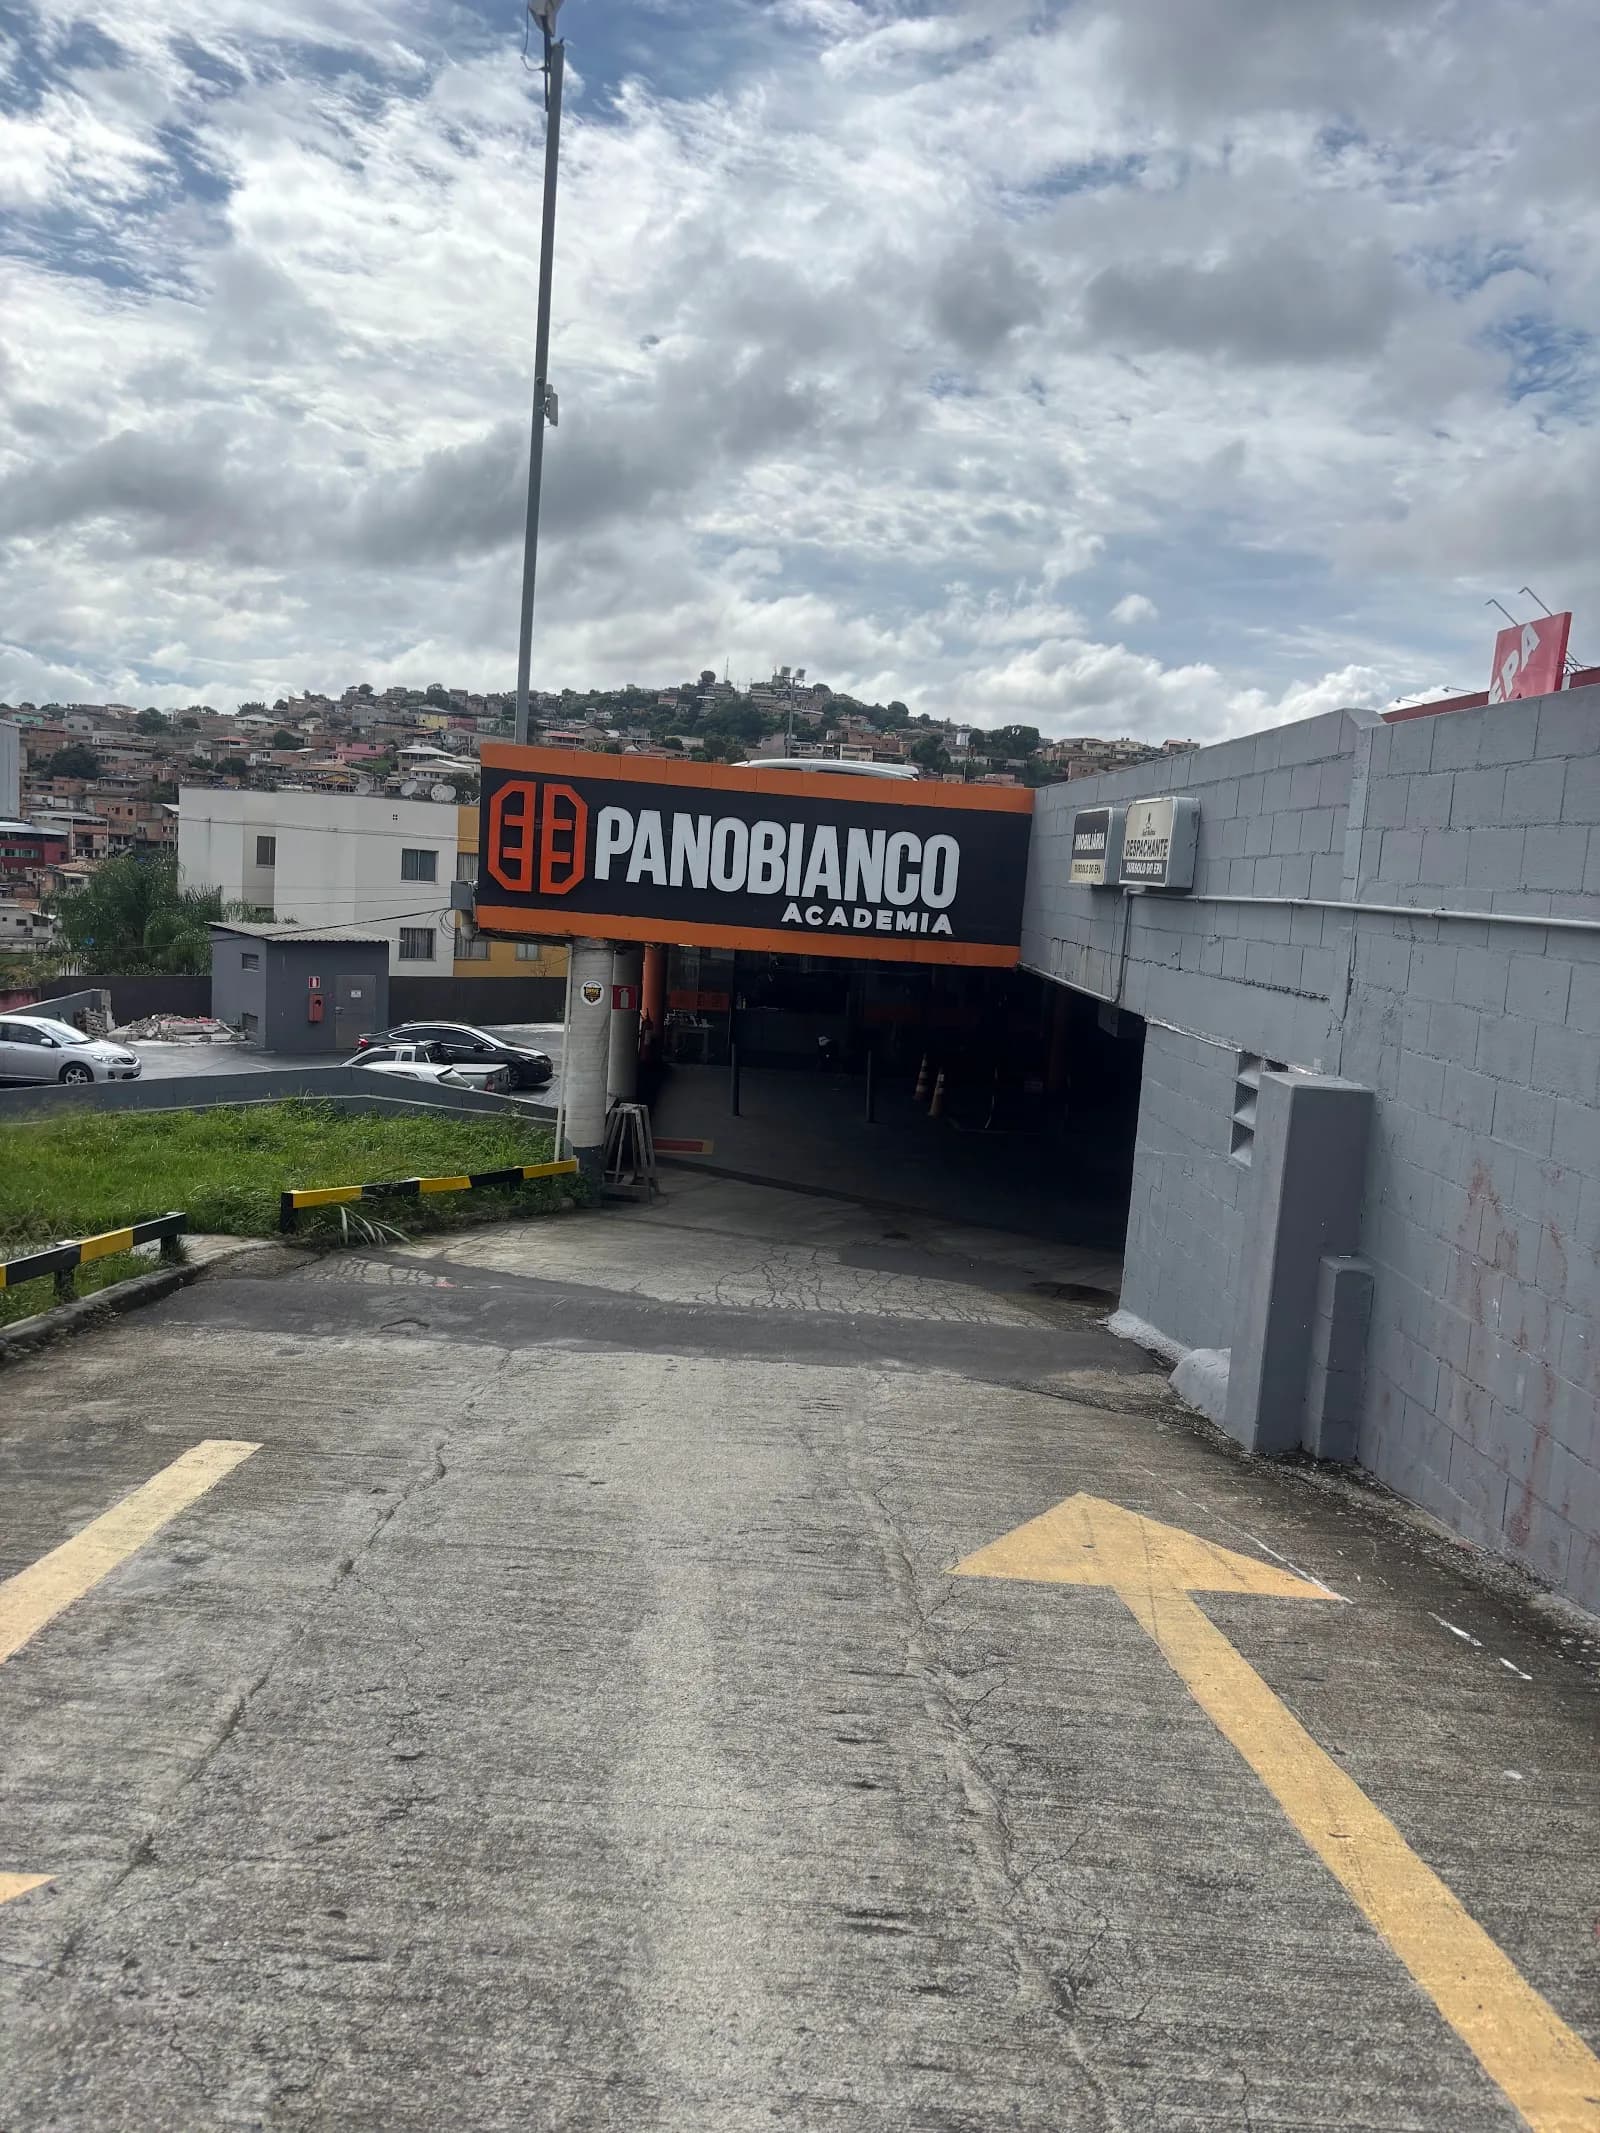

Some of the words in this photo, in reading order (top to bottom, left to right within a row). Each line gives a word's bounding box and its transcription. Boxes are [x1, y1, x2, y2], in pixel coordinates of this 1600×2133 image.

[594, 806, 961, 909] PANOBIANCO
[1126, 839, 1168, 857] DESPACHANTE
[1126, 863, 1146, 873] SUBSOLO
[1146, 863, 1153, 874] DO
[1153, 863, 1162, 875] EPA
[781, 902, 953, 936] ACADEMIA
